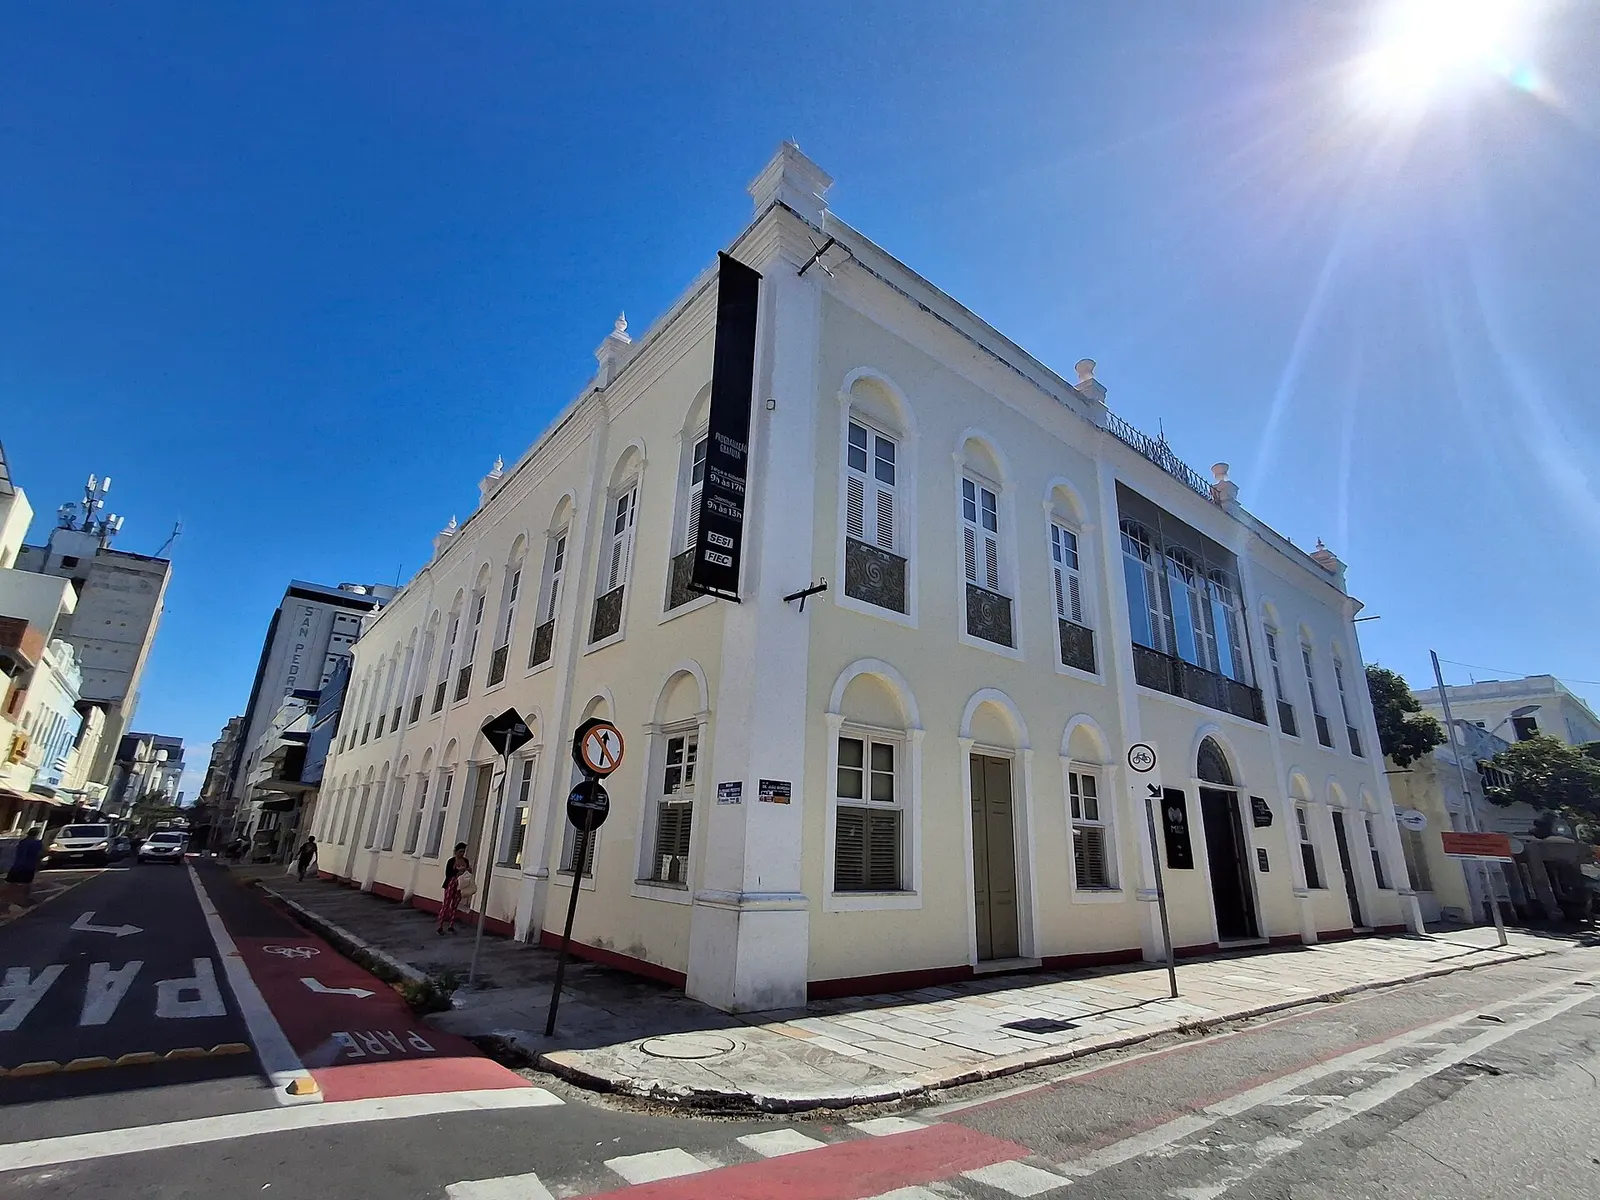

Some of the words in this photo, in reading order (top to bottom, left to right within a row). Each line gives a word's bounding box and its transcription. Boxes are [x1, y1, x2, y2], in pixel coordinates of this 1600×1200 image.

[731, 482, 744, 493] 17h
[728, 508, 742, 519] 13h
[709, 533, 731, 547] SESI
[707, 552, 729, 565] FIEC
[299, 606, 314, 637] SAN
[331, 1029, 436, 1058] PARE
